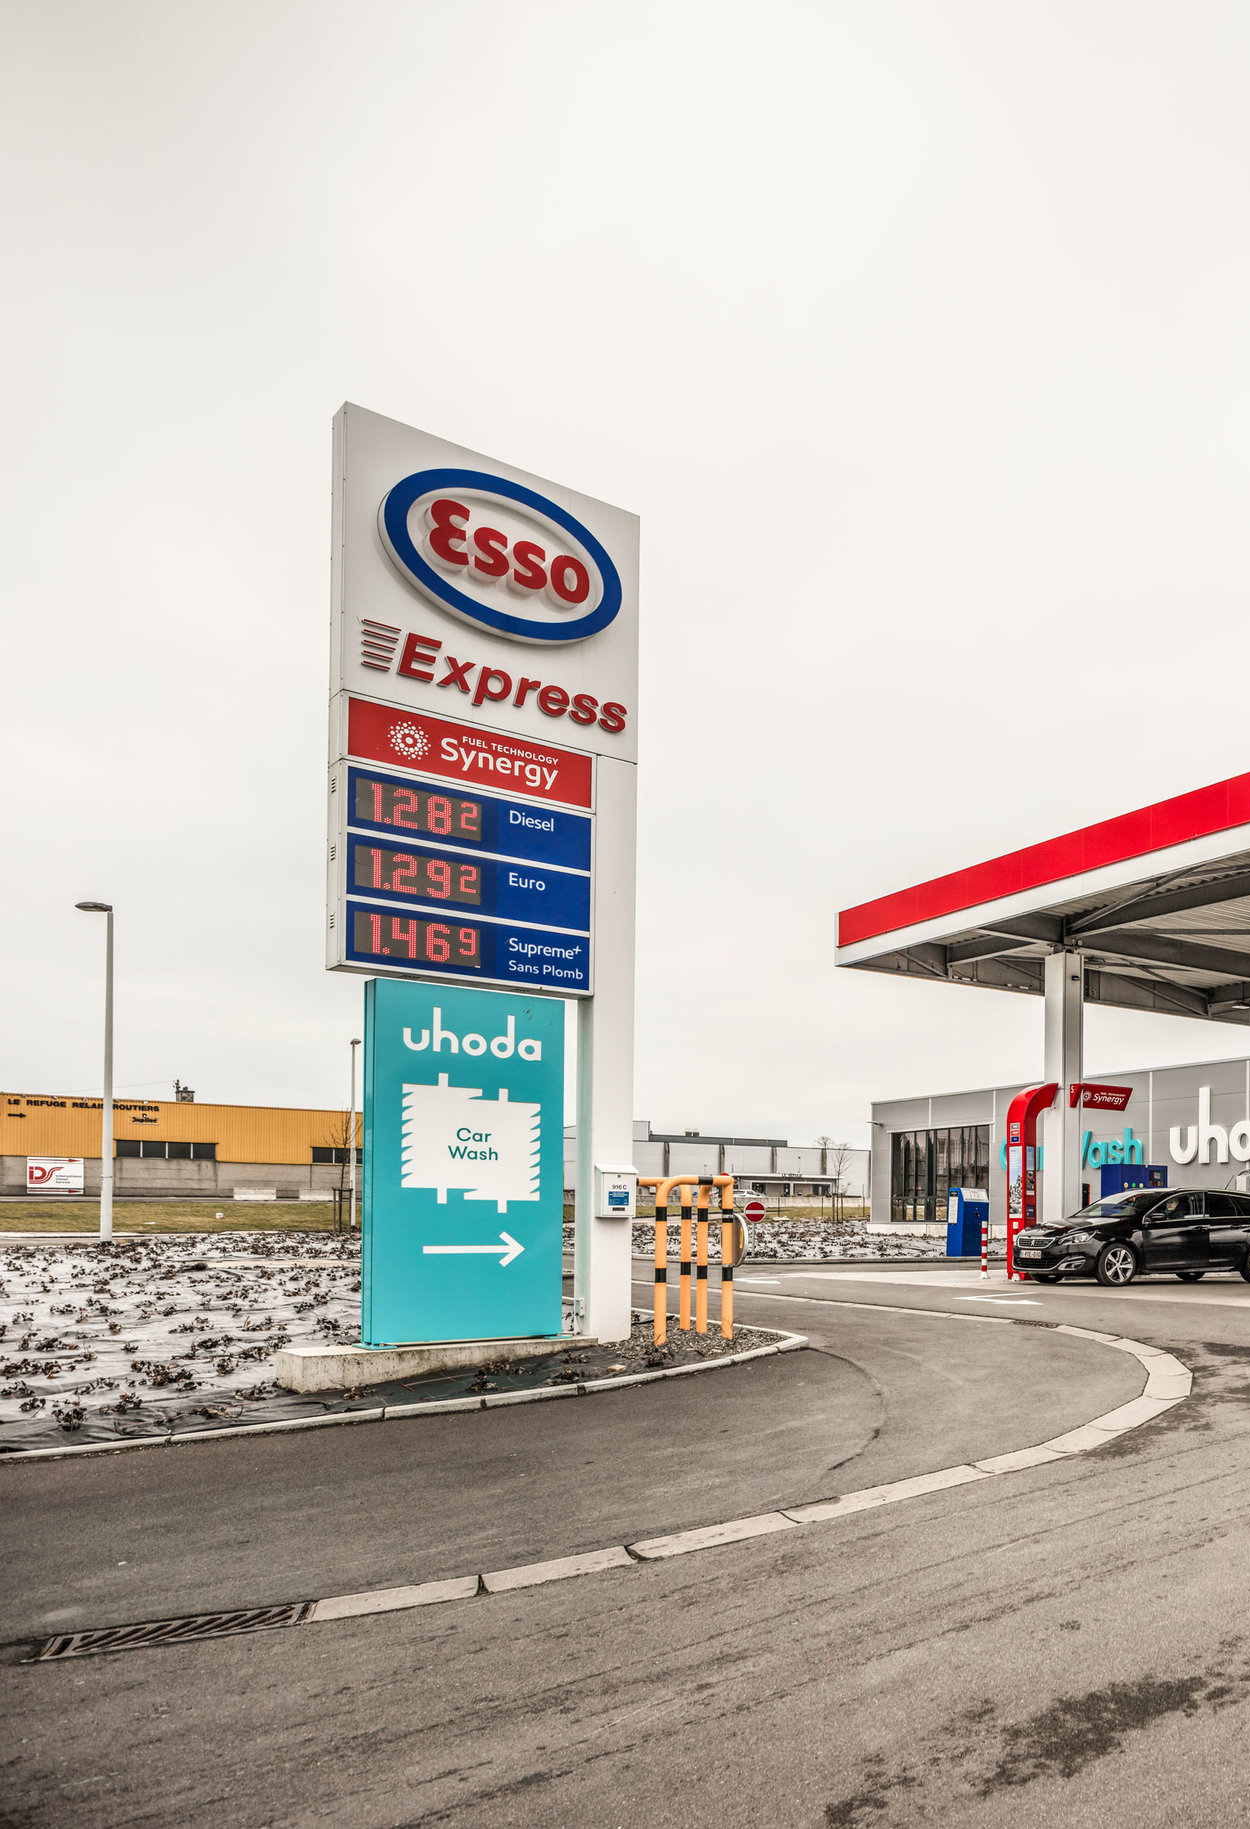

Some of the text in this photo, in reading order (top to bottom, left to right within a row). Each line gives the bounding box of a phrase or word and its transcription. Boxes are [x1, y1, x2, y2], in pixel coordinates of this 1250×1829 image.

[396, 632, 628, 733] Express
[462, 735, 559, 766] FUEL TECHNOLOGY
[440, 737, 559, 790] Synergy
[509, 810, 554, 833] Diesel
[508, 872, 546, 891] Euro
[508, 960, 584, 980] Sans Plomb
[403, 1006, 542, 1061] uhoda
[8, 1098, 20, 1106] LE
[26, 1099, 67, 1108] REFUGE
[112, 1104, 160, 1112] ROUTIERS
[1093, 1093, 1125, 1105] Synergy
[456, 1127, 492, 1144] Car
[448, 1144, 499, 1162] Wash
[1082, 1127, 1143, 1169] ash
